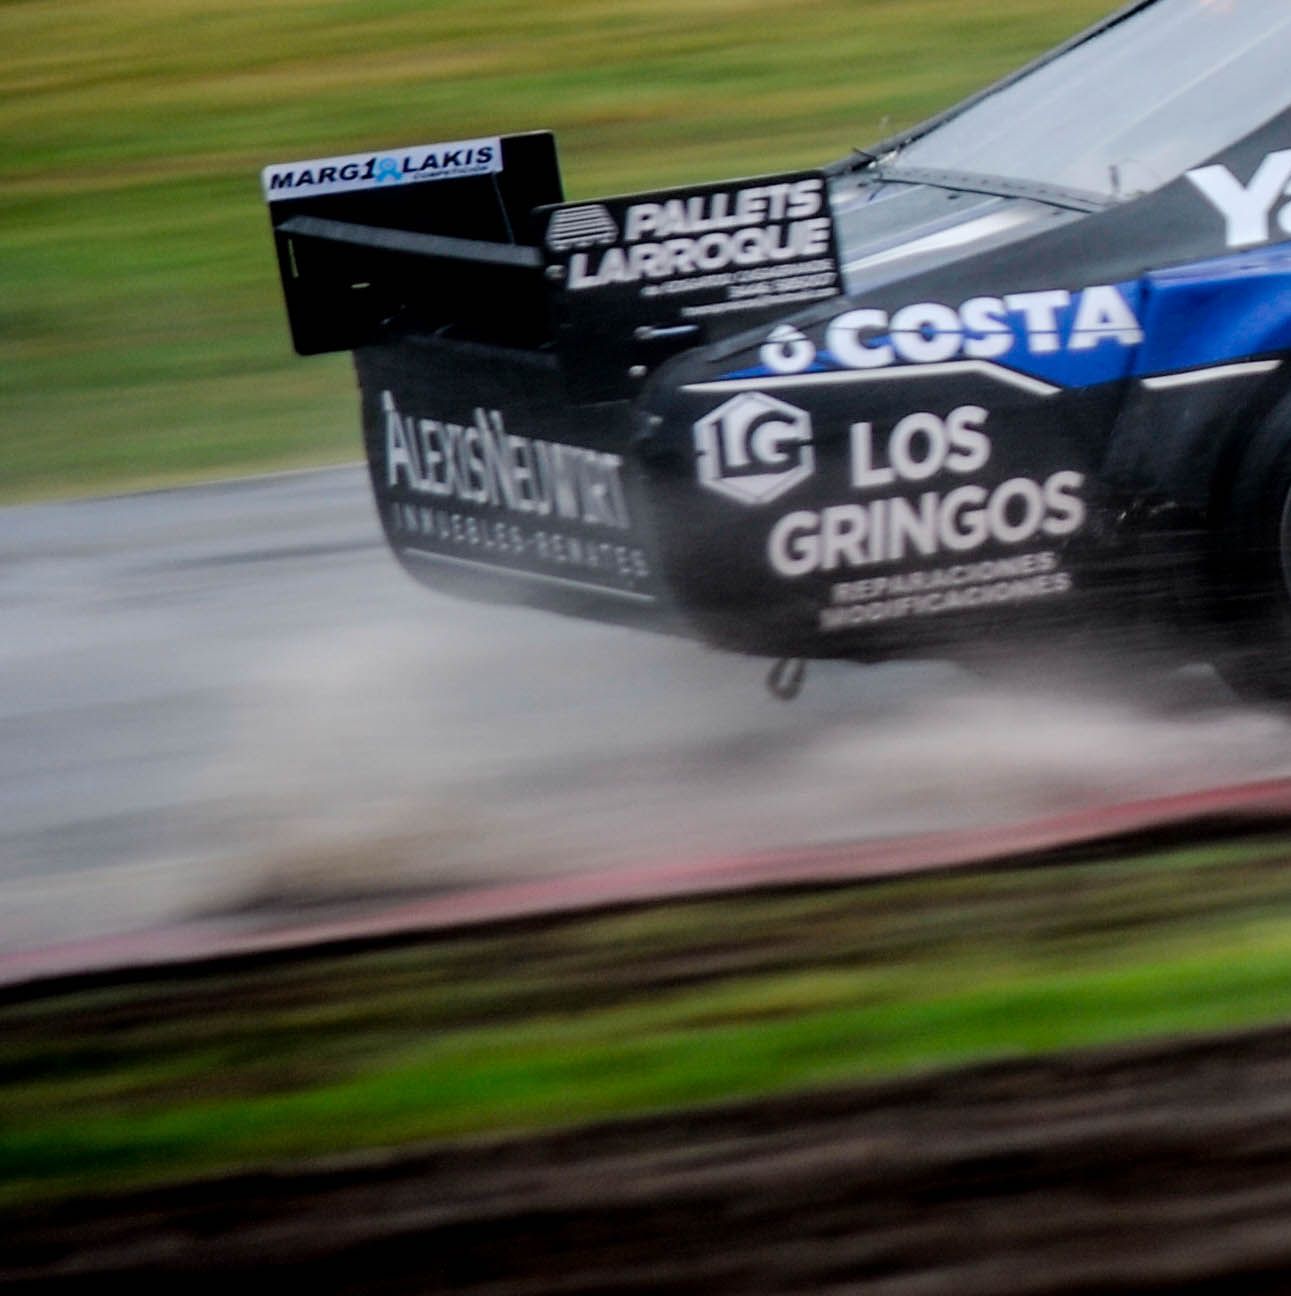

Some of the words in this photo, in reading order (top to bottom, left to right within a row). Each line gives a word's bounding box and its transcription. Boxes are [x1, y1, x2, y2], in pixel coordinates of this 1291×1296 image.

[625, 178, 824, 241] PALLETS
[567, 217, 831, 290] LARROQUE
[826, 286, 1144, 368] COSTA
[849, 404, 992, 489] LOS
[769, 471, 1087, 576] GRINGOS
